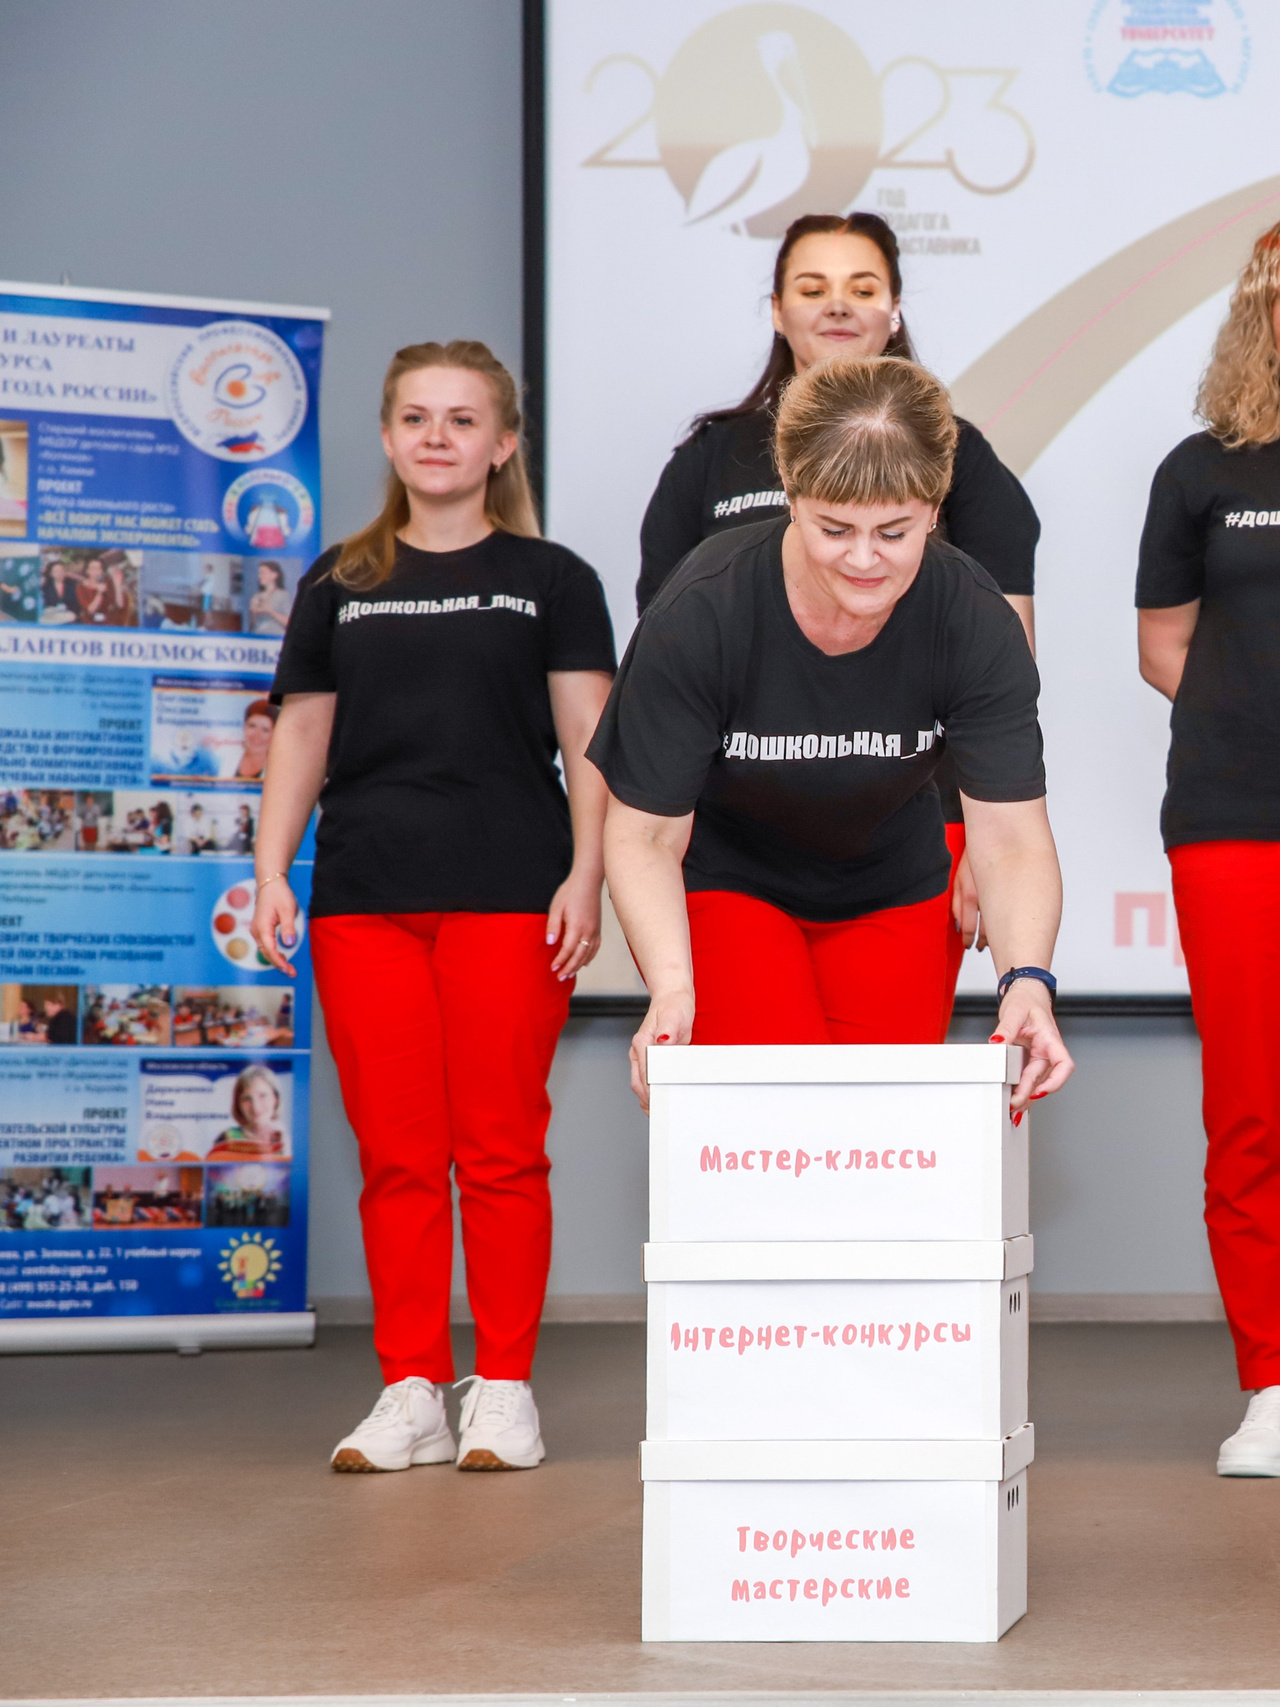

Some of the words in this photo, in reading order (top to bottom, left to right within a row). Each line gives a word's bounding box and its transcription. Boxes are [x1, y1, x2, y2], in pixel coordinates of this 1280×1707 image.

[3, 329, 17, 344] И
[23, 330, 136, 352] ЛАУРЕАТЫ
[2, 379, 55, 397] ГОДА
[338, 594, 537, 624] #ДОШКОЛЬНАЯ_ЛИГА
[700, 1145, 937, 1178] Мастер-классы
[737, 1526, 915, 1558] Творческие
[731, 1576, 911, 1606] мастерские
